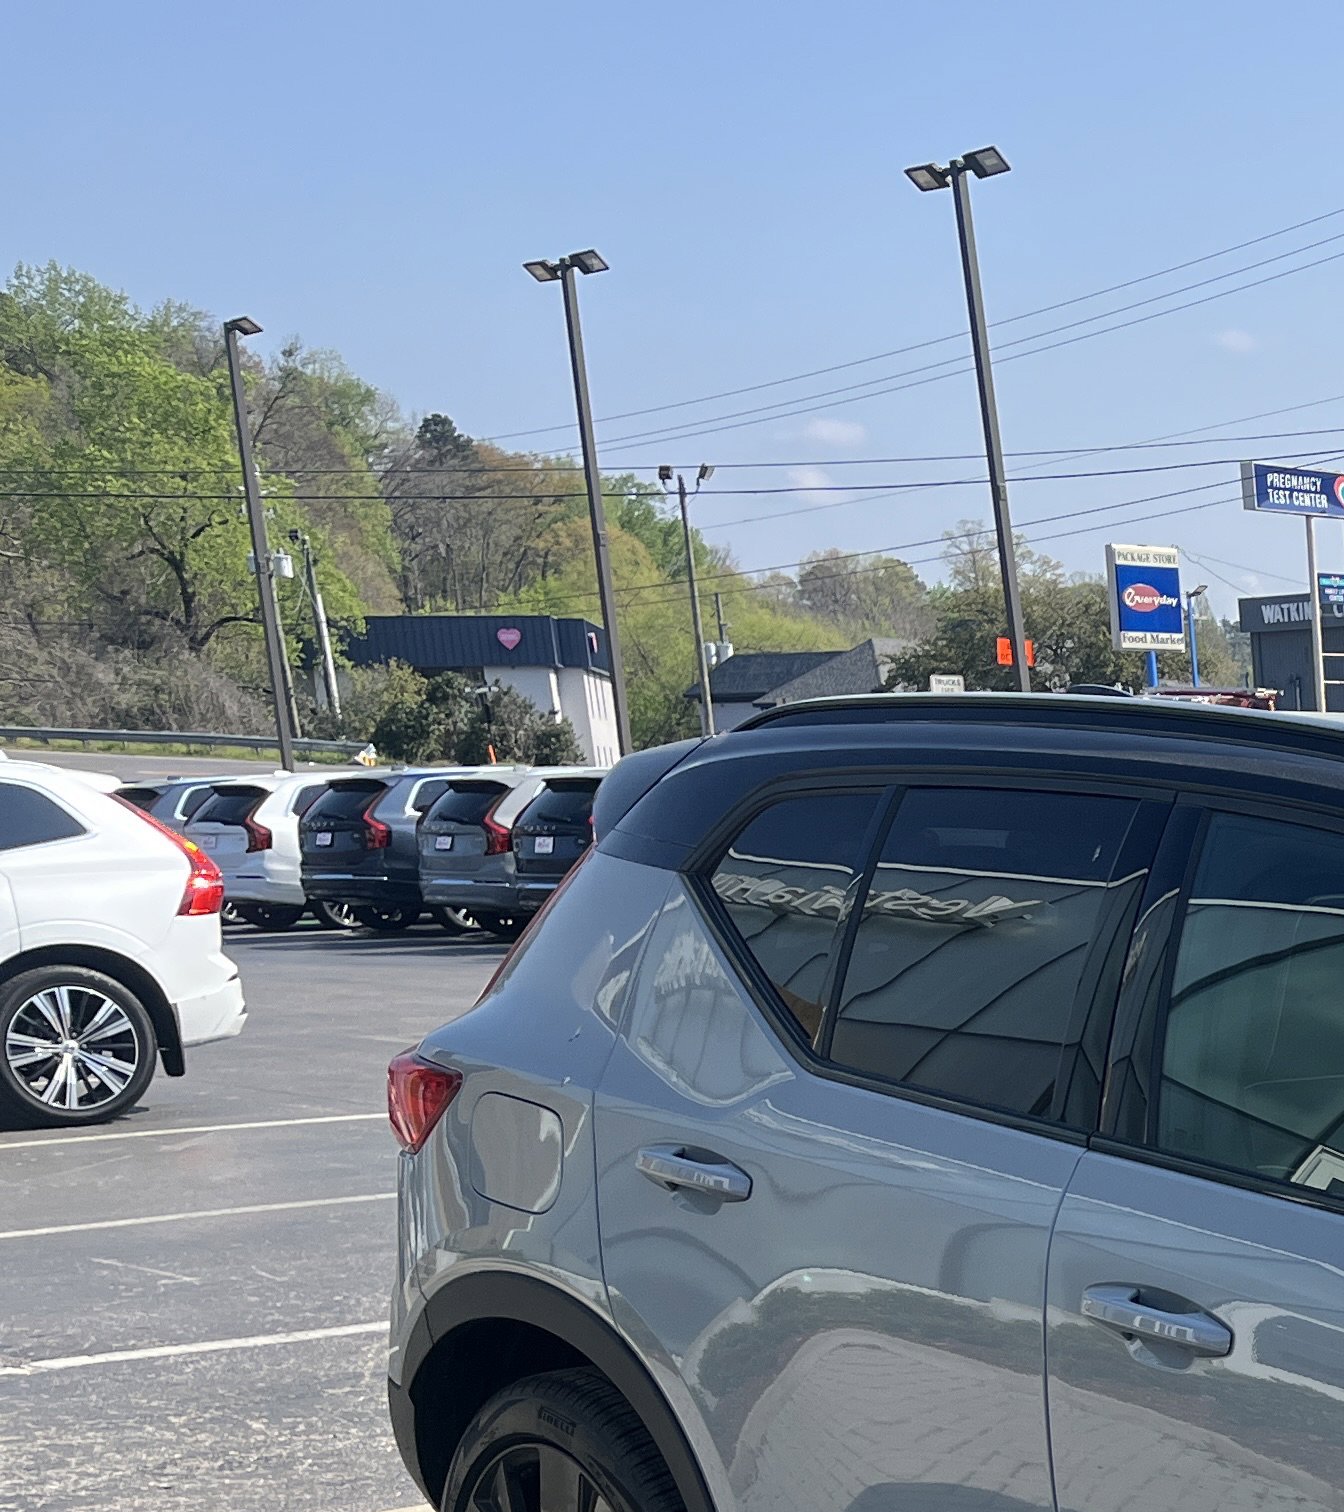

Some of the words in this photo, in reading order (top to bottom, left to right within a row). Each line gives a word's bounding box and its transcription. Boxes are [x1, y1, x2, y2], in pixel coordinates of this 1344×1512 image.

[1267, 473, 1322, 492] PREGNANCY
[1267, 489, 1290, 504] TEST
[1293, 492, 1329, 509] CENTER
[1117, 551, 1150, 562] PACKAGE
[1153, 553, 1178, 565] STORE
[1124, 587, 1178, 608] Everyday
[1261, 601, 1320, 624] WATKIN
[1122, 633, 1148, 644] Food
[1150, 634, 1185, 646] Market
